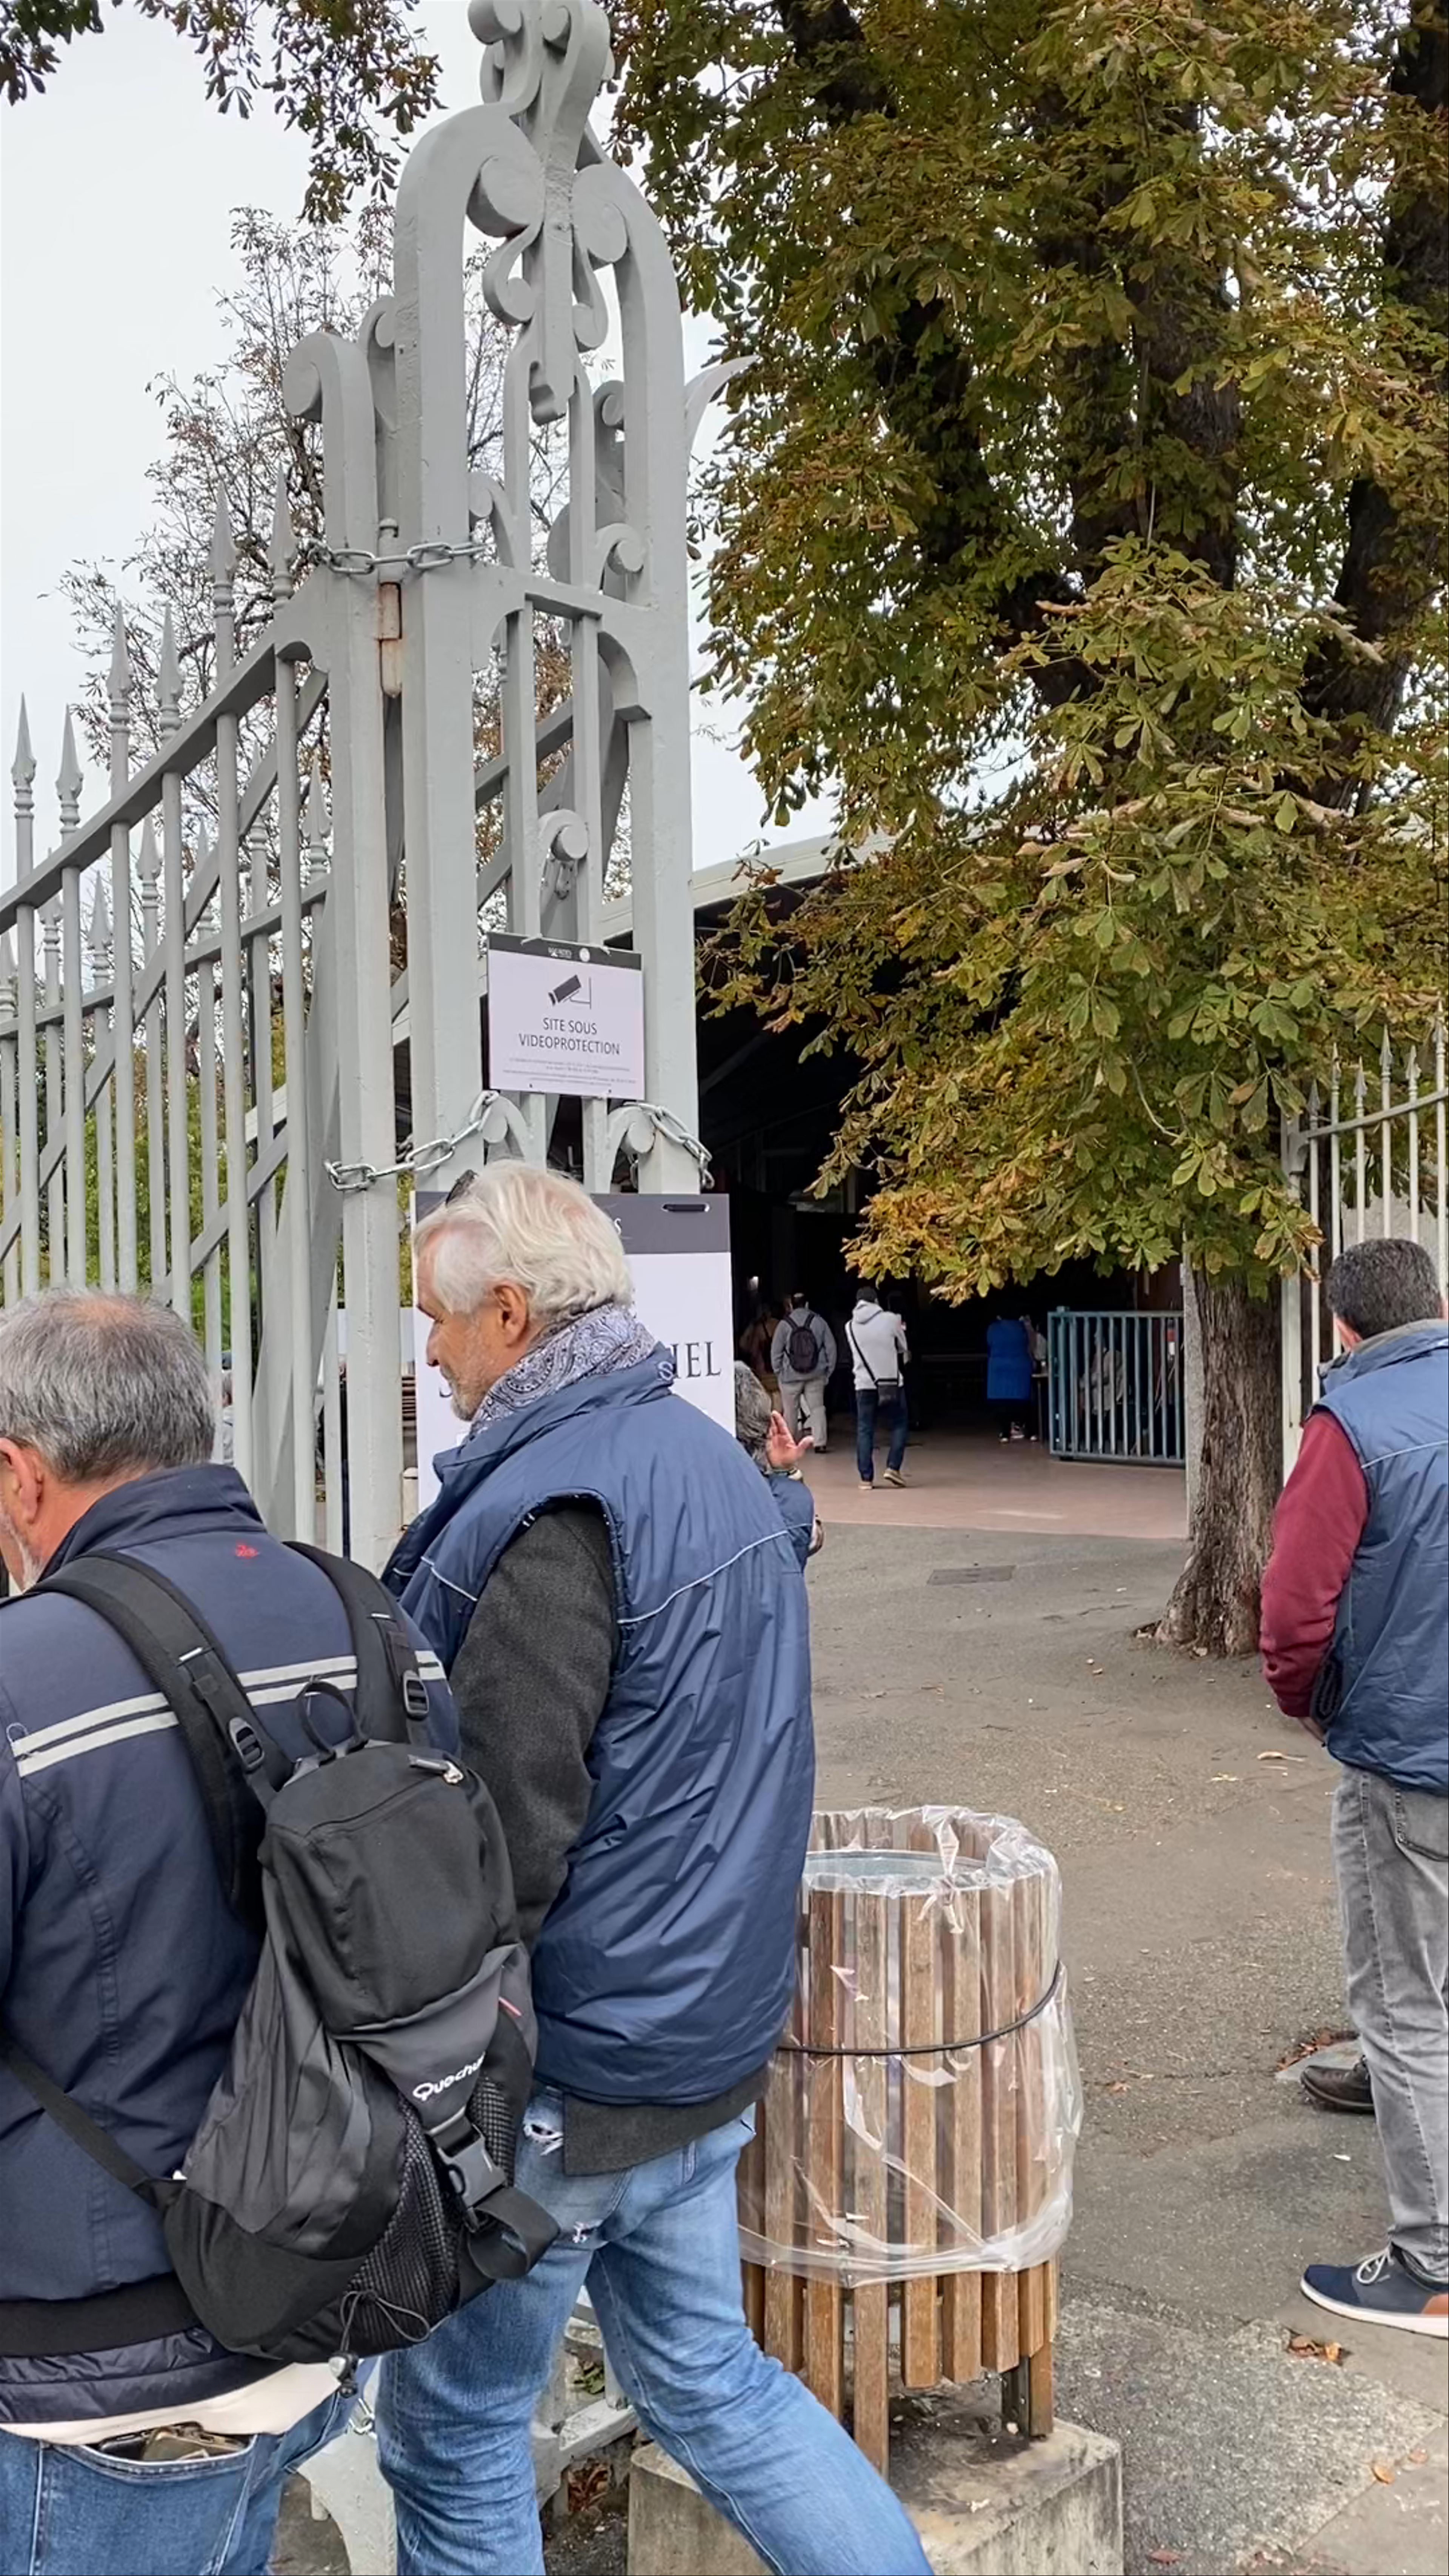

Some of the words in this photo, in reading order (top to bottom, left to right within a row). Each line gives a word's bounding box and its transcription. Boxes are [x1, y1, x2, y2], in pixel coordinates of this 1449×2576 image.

[543, 1018, 565, 1032] SITE
[569, 1020, 597, 1035] SOUS
[519, 1033, 620, 1054] VIDEOPROTECTION
